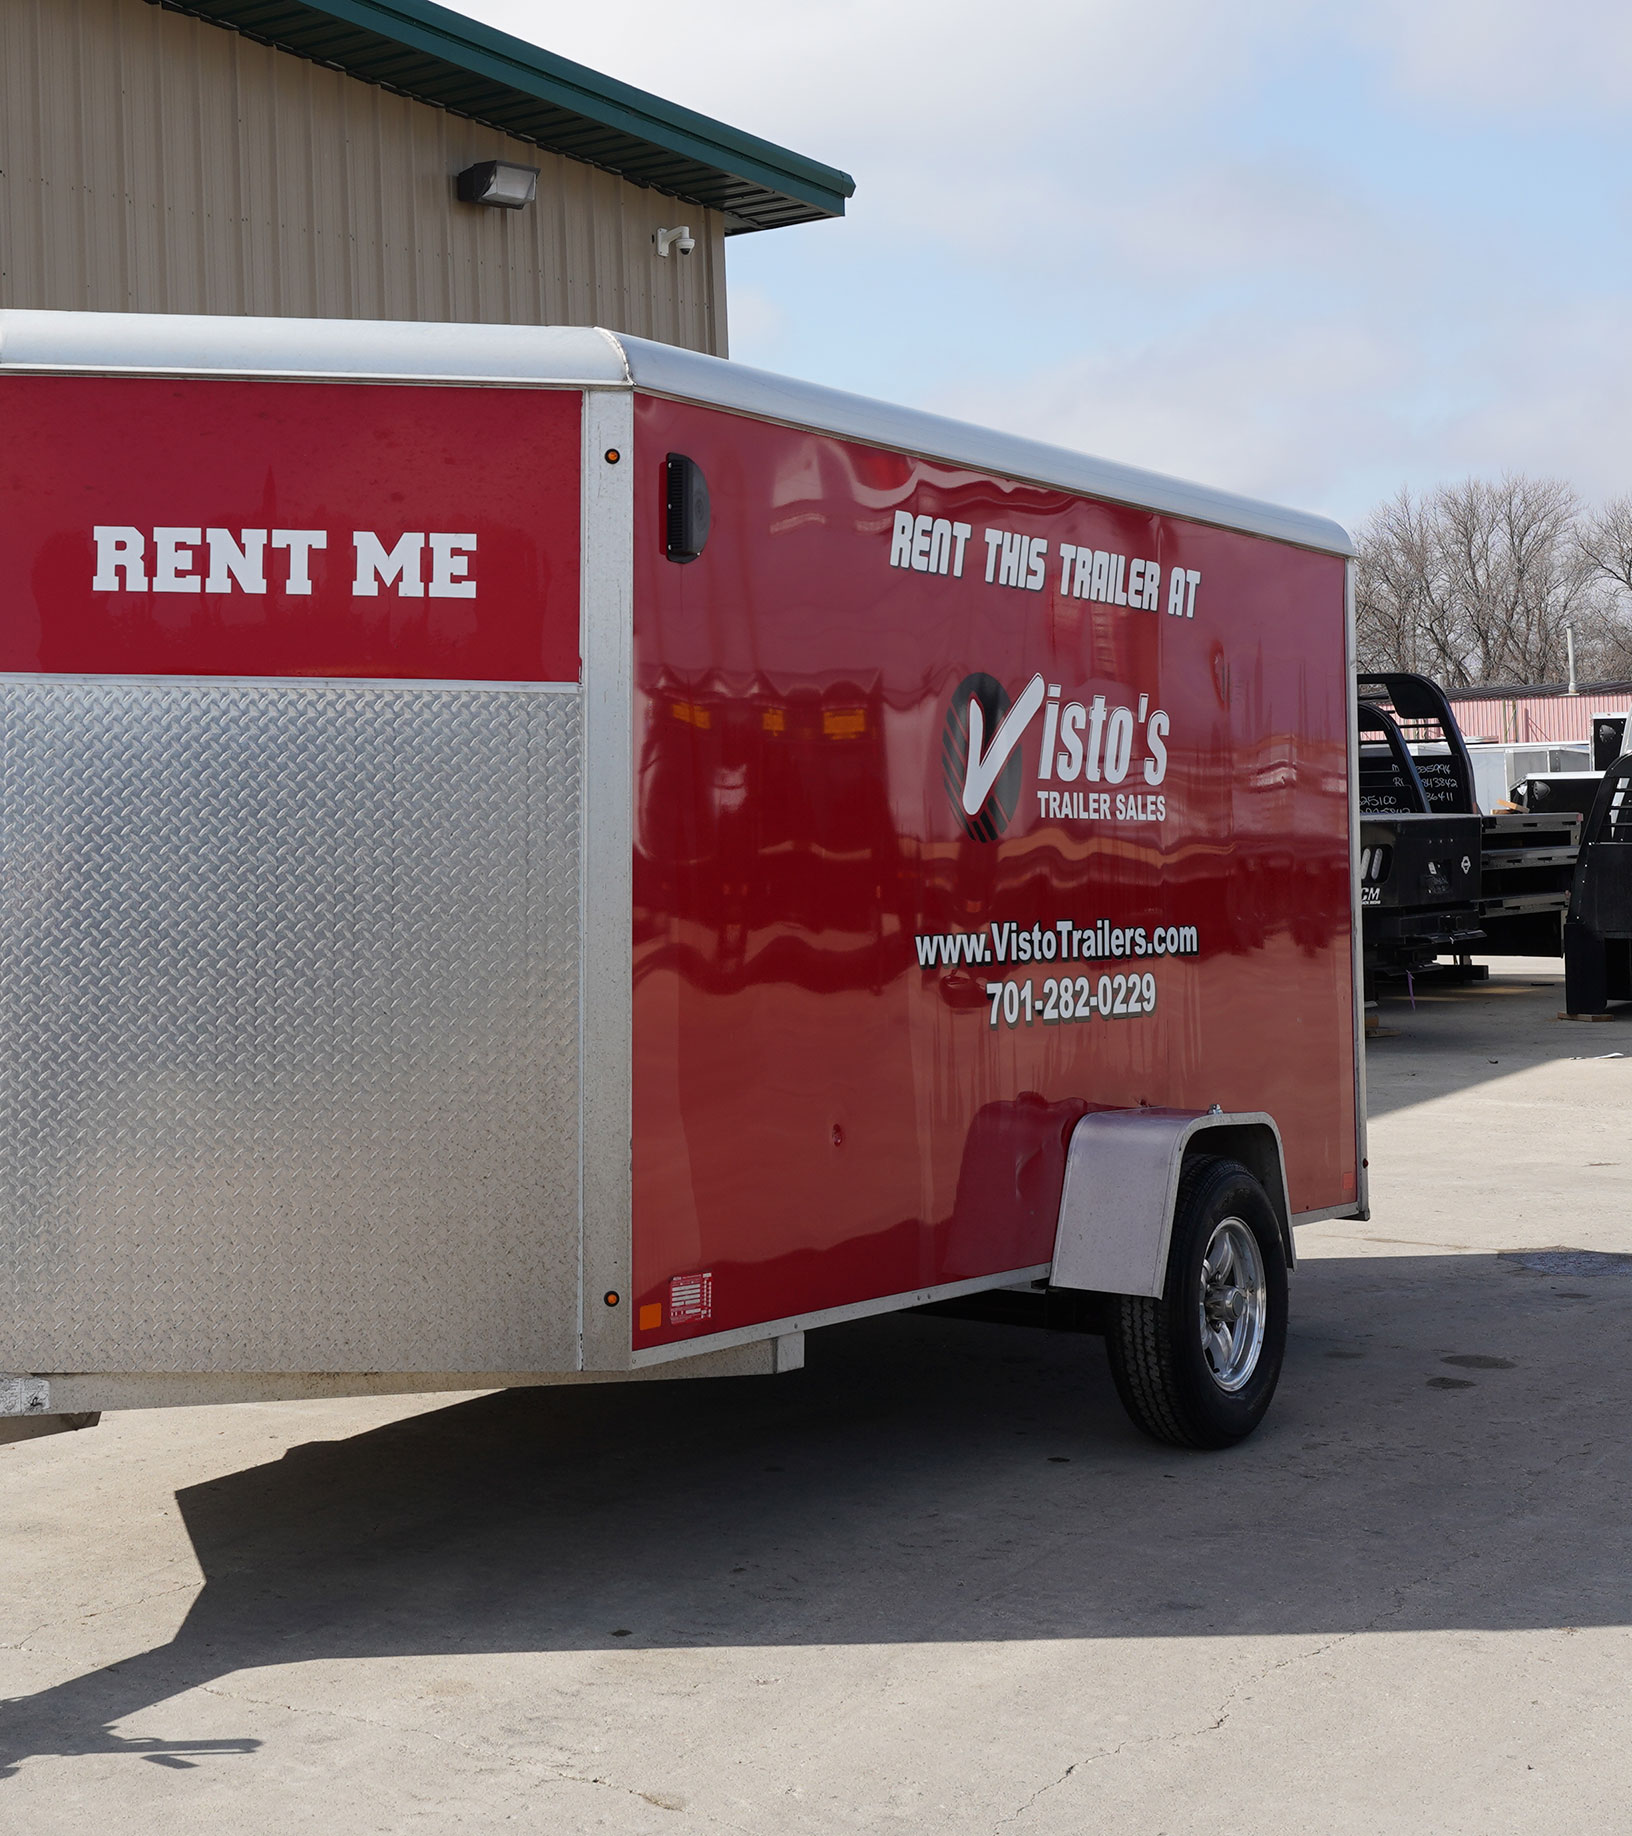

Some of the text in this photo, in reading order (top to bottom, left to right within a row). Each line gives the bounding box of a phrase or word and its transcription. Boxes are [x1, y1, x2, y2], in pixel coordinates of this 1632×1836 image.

[92, 525, 477, 598] RENT ME
[889, 510, 1202, 619] RENT THIS TRAILER AT
[961, 672, 1171, 816] Visto's
[1037, 791, 1167, 822] TRAILER SALES
[1359, 795, 1397, 807] 25100
[915, 919, 1199, 969] www.VistoTrailers.com
[986, 973, 1156, 1028] 701-282-0229
